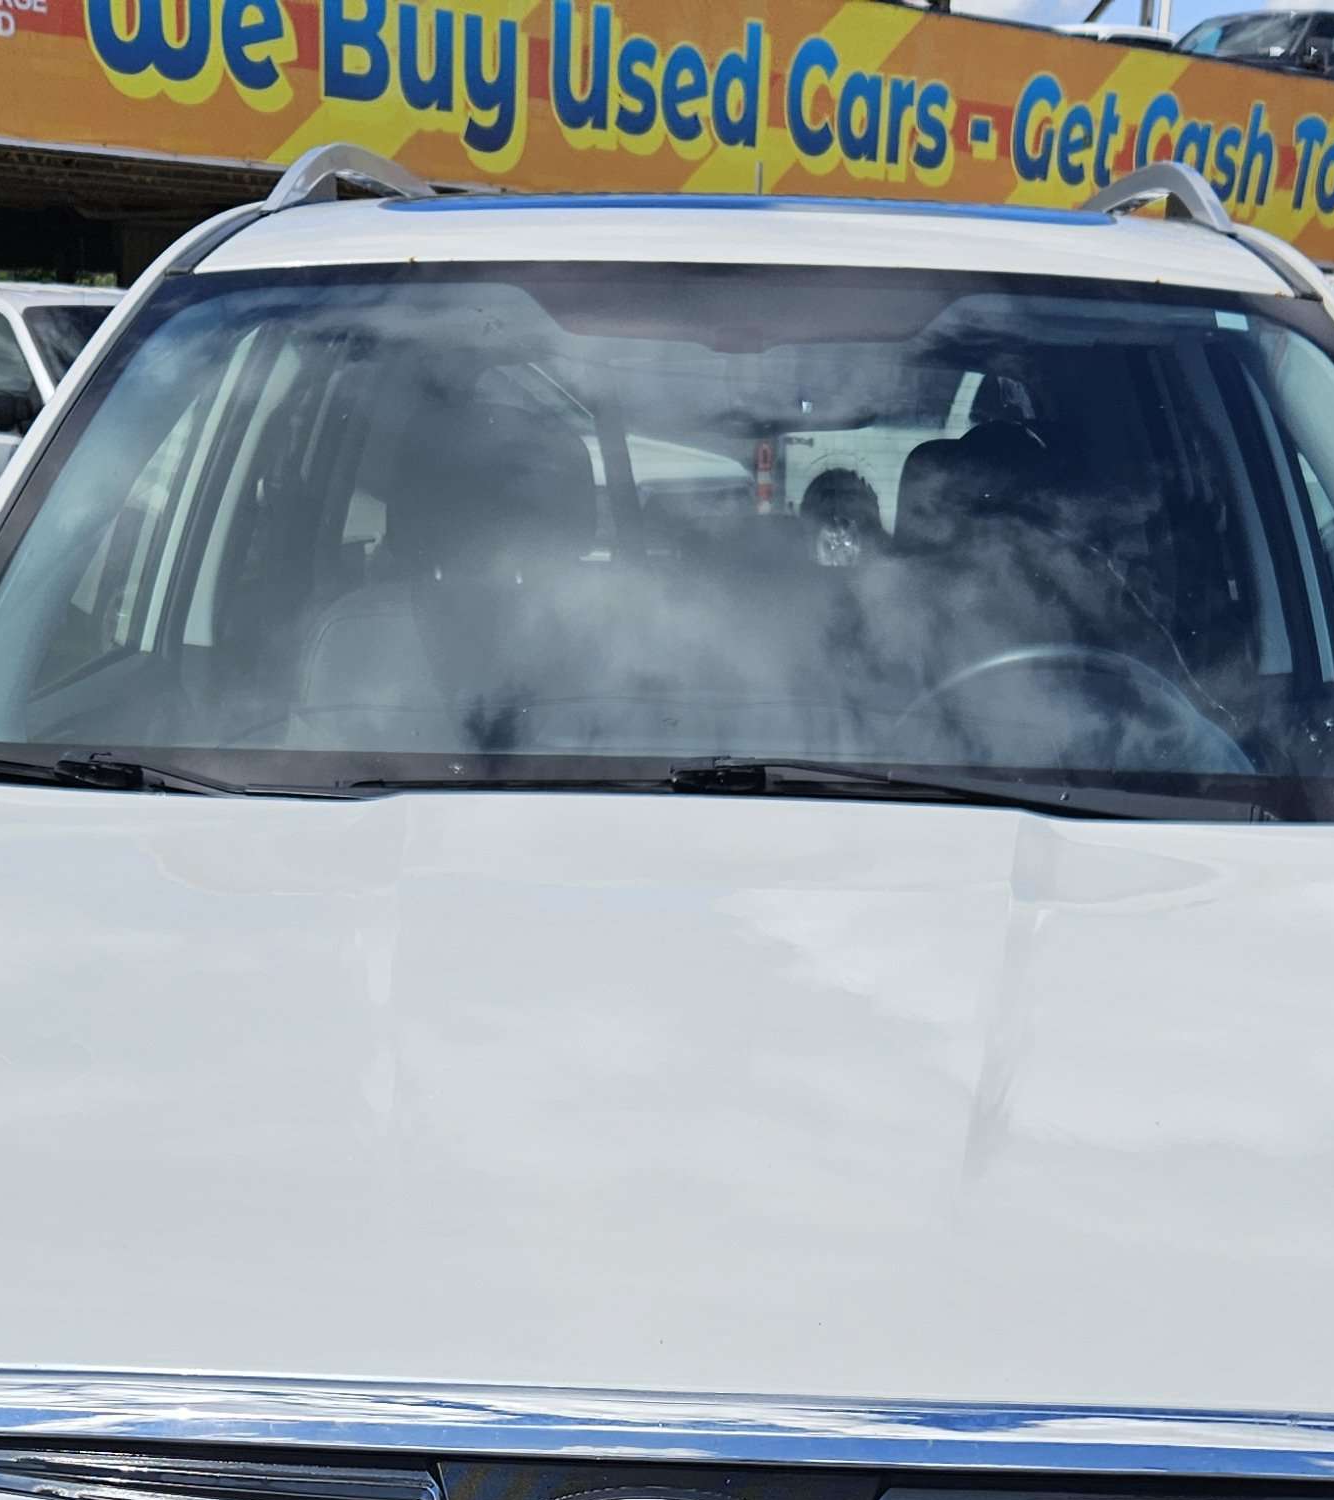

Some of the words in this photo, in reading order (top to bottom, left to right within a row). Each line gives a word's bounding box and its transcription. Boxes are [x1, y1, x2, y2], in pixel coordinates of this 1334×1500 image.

[322, 0, 518, 154] Buy
[553, 0, 763, 149] Used
[786, 36, 950, 170] Cars
[1012, 74, 1121, 188] Get
[1134, 92, 1275, 207] Cash
